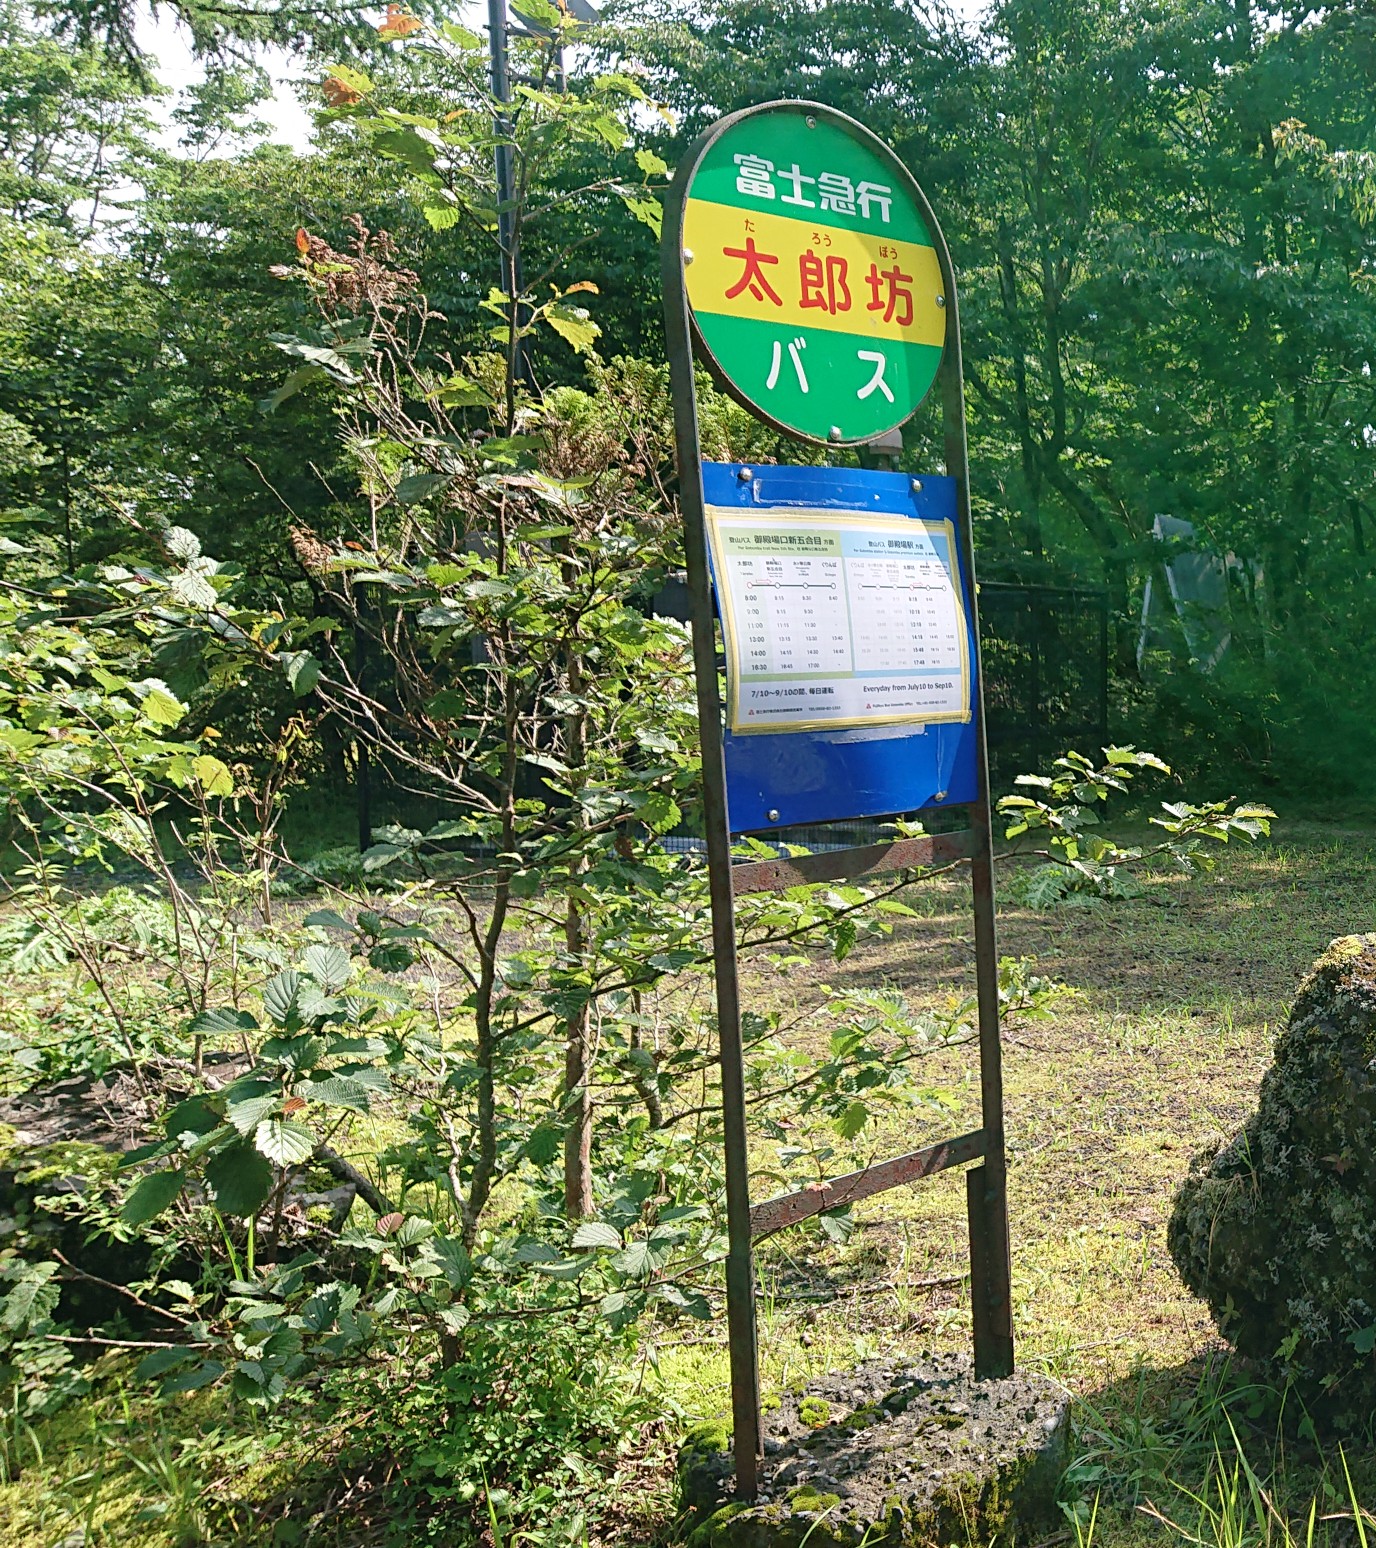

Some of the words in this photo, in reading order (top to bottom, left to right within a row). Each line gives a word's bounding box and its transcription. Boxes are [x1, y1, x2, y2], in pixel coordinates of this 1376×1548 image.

[733, 154, 892, 223] 富士急行
[744, 219, 756, 233] た
[811, 232, 832, 248] ろう
[723, 238, 914, 326] 太郎坊
[766, 336, 895, 403] バス
[754, 535, 822, 545] 御殿場口新五合目
[888, 540, 914, 549] 御殿場駅
[908, 683, 926, 691] July10
